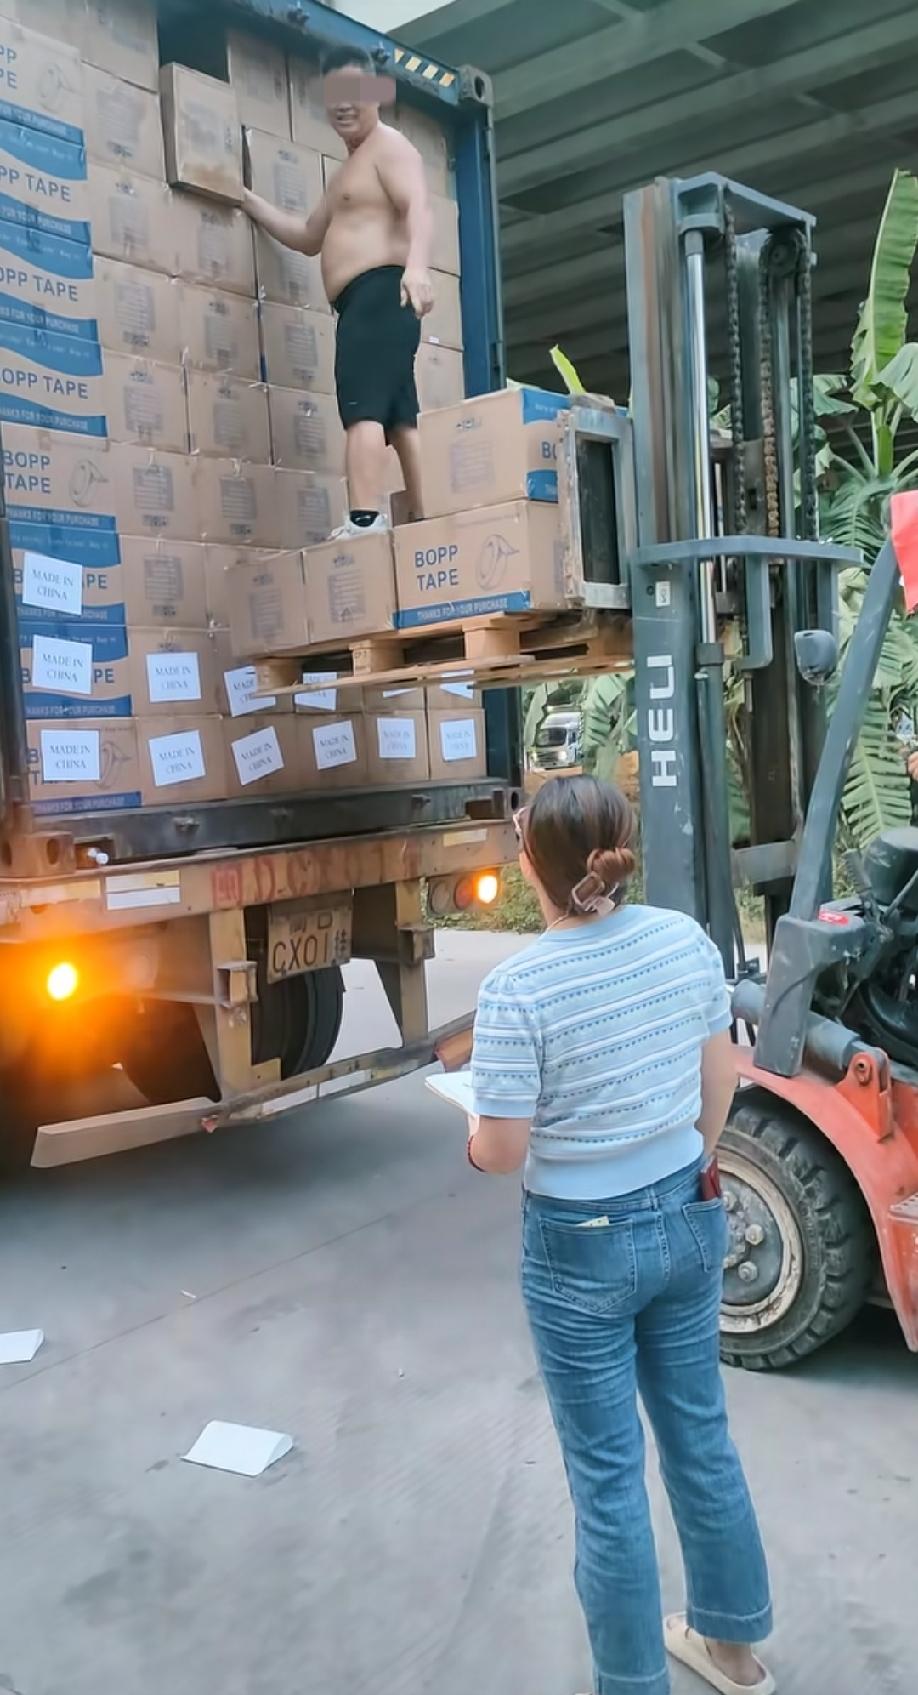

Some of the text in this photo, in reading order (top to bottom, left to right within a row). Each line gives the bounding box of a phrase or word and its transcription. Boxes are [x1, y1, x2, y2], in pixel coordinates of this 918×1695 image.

[25, 173, 71, 202] TAPE
[33, 275, 78, 301] TAPE
[43, 375, 88, 399] TAPE
[3, 450, 50, 470] BOPP
[4, 472, 51, 494] TAPE
[415, 545, 458, 568] BOPP
[32, 569, 60, 585] MADE
[63, 576, 73, 587] IN
[417, 568, 459, 592] TAPE
[37, 585, 68, 600] CHINA
[473, 597, 508, 613] PURCHASE
[42, 653, 83, 668] MADE IN
[47, 668, 78, 683] CHINA
[155, 664, 192, 677] MADE IN
[161, 679, 188, 690] CHINA
[647, 654, 677, 787] HELI
[50, 744, 91, 754] MADE IN
[159, 746, 196, 761] MADE IN
[241, 742, 273, 760] MADE IN
[55, 759, 88, 769] CHINA
[165, 761, 193, 775] CHINA
[249, 757, 273, 771] CHINA
